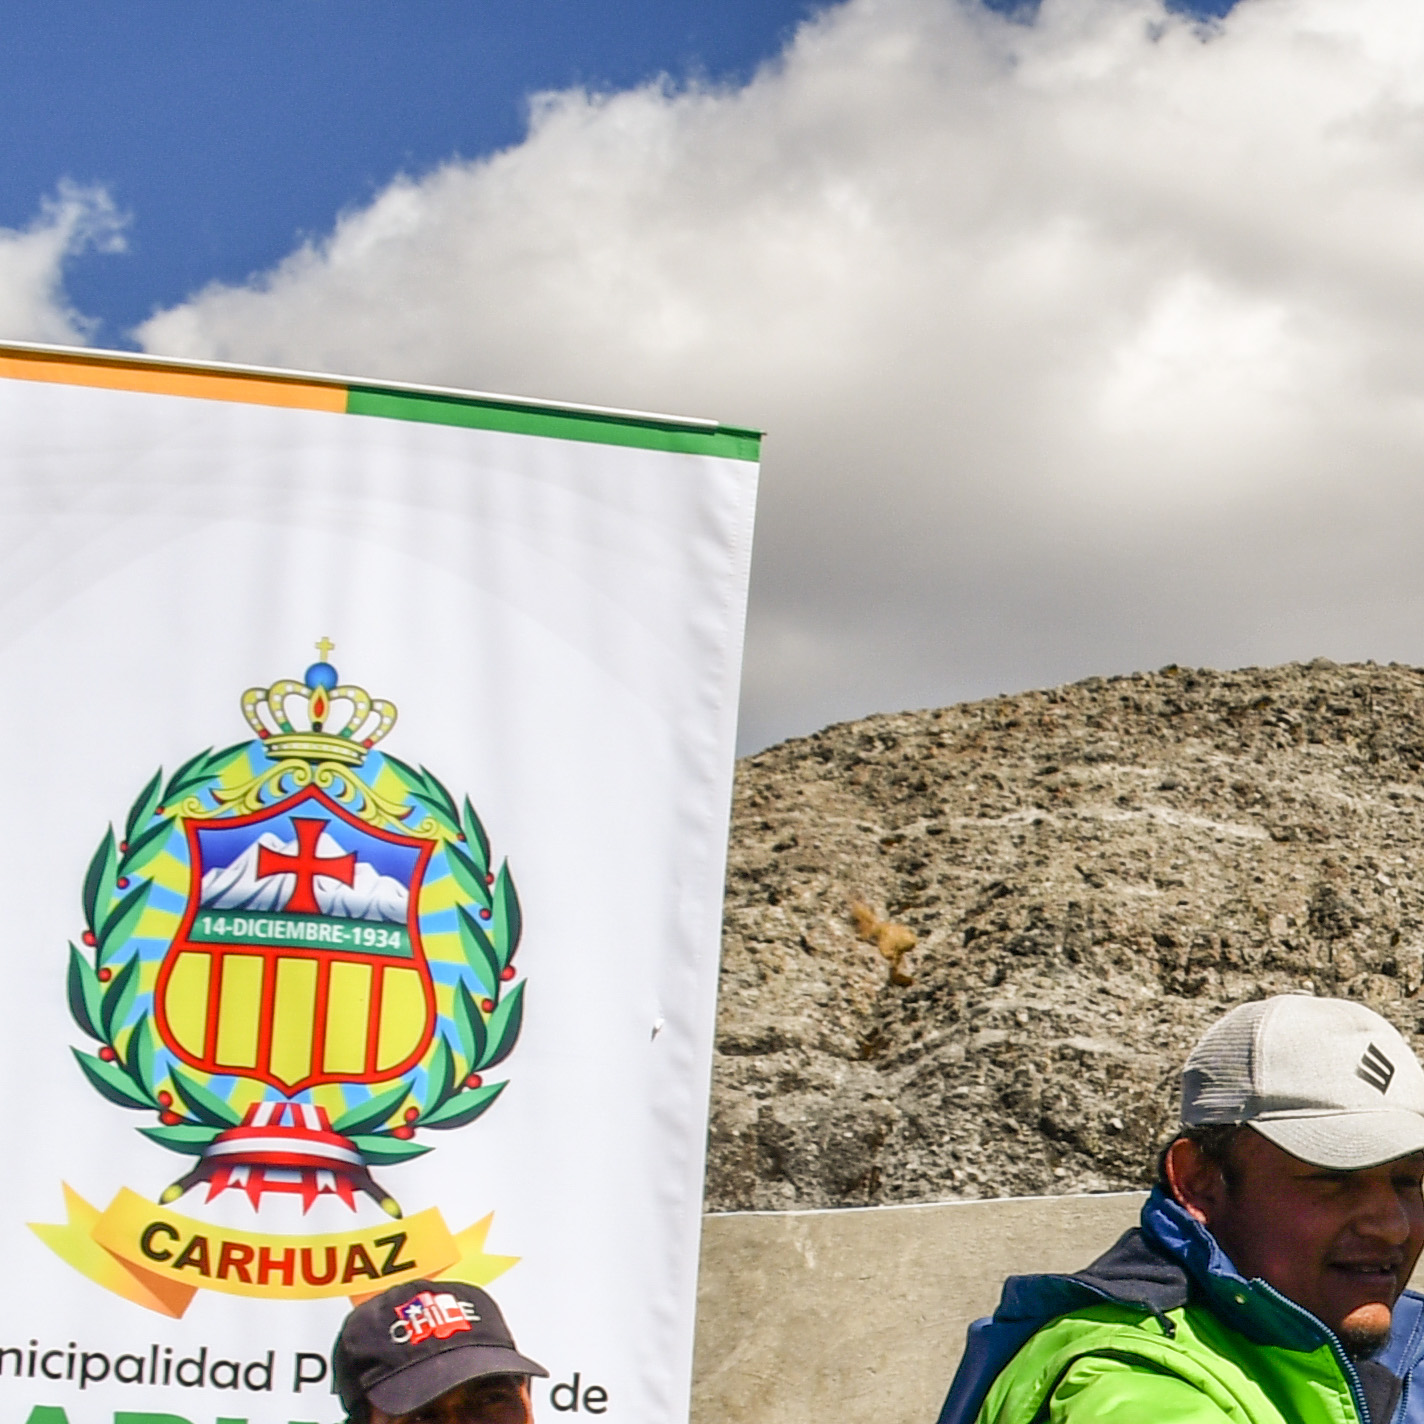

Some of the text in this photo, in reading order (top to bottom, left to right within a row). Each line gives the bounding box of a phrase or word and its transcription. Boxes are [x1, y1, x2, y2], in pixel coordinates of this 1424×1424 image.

[202, 916, 401, 949] 14-DICIEMBRE-1934
[139, 1221, 417, 1287] CARHUAZ
[389, 1296, 481, 1343] CHILE
[549, 1371, 610, 1415] de
